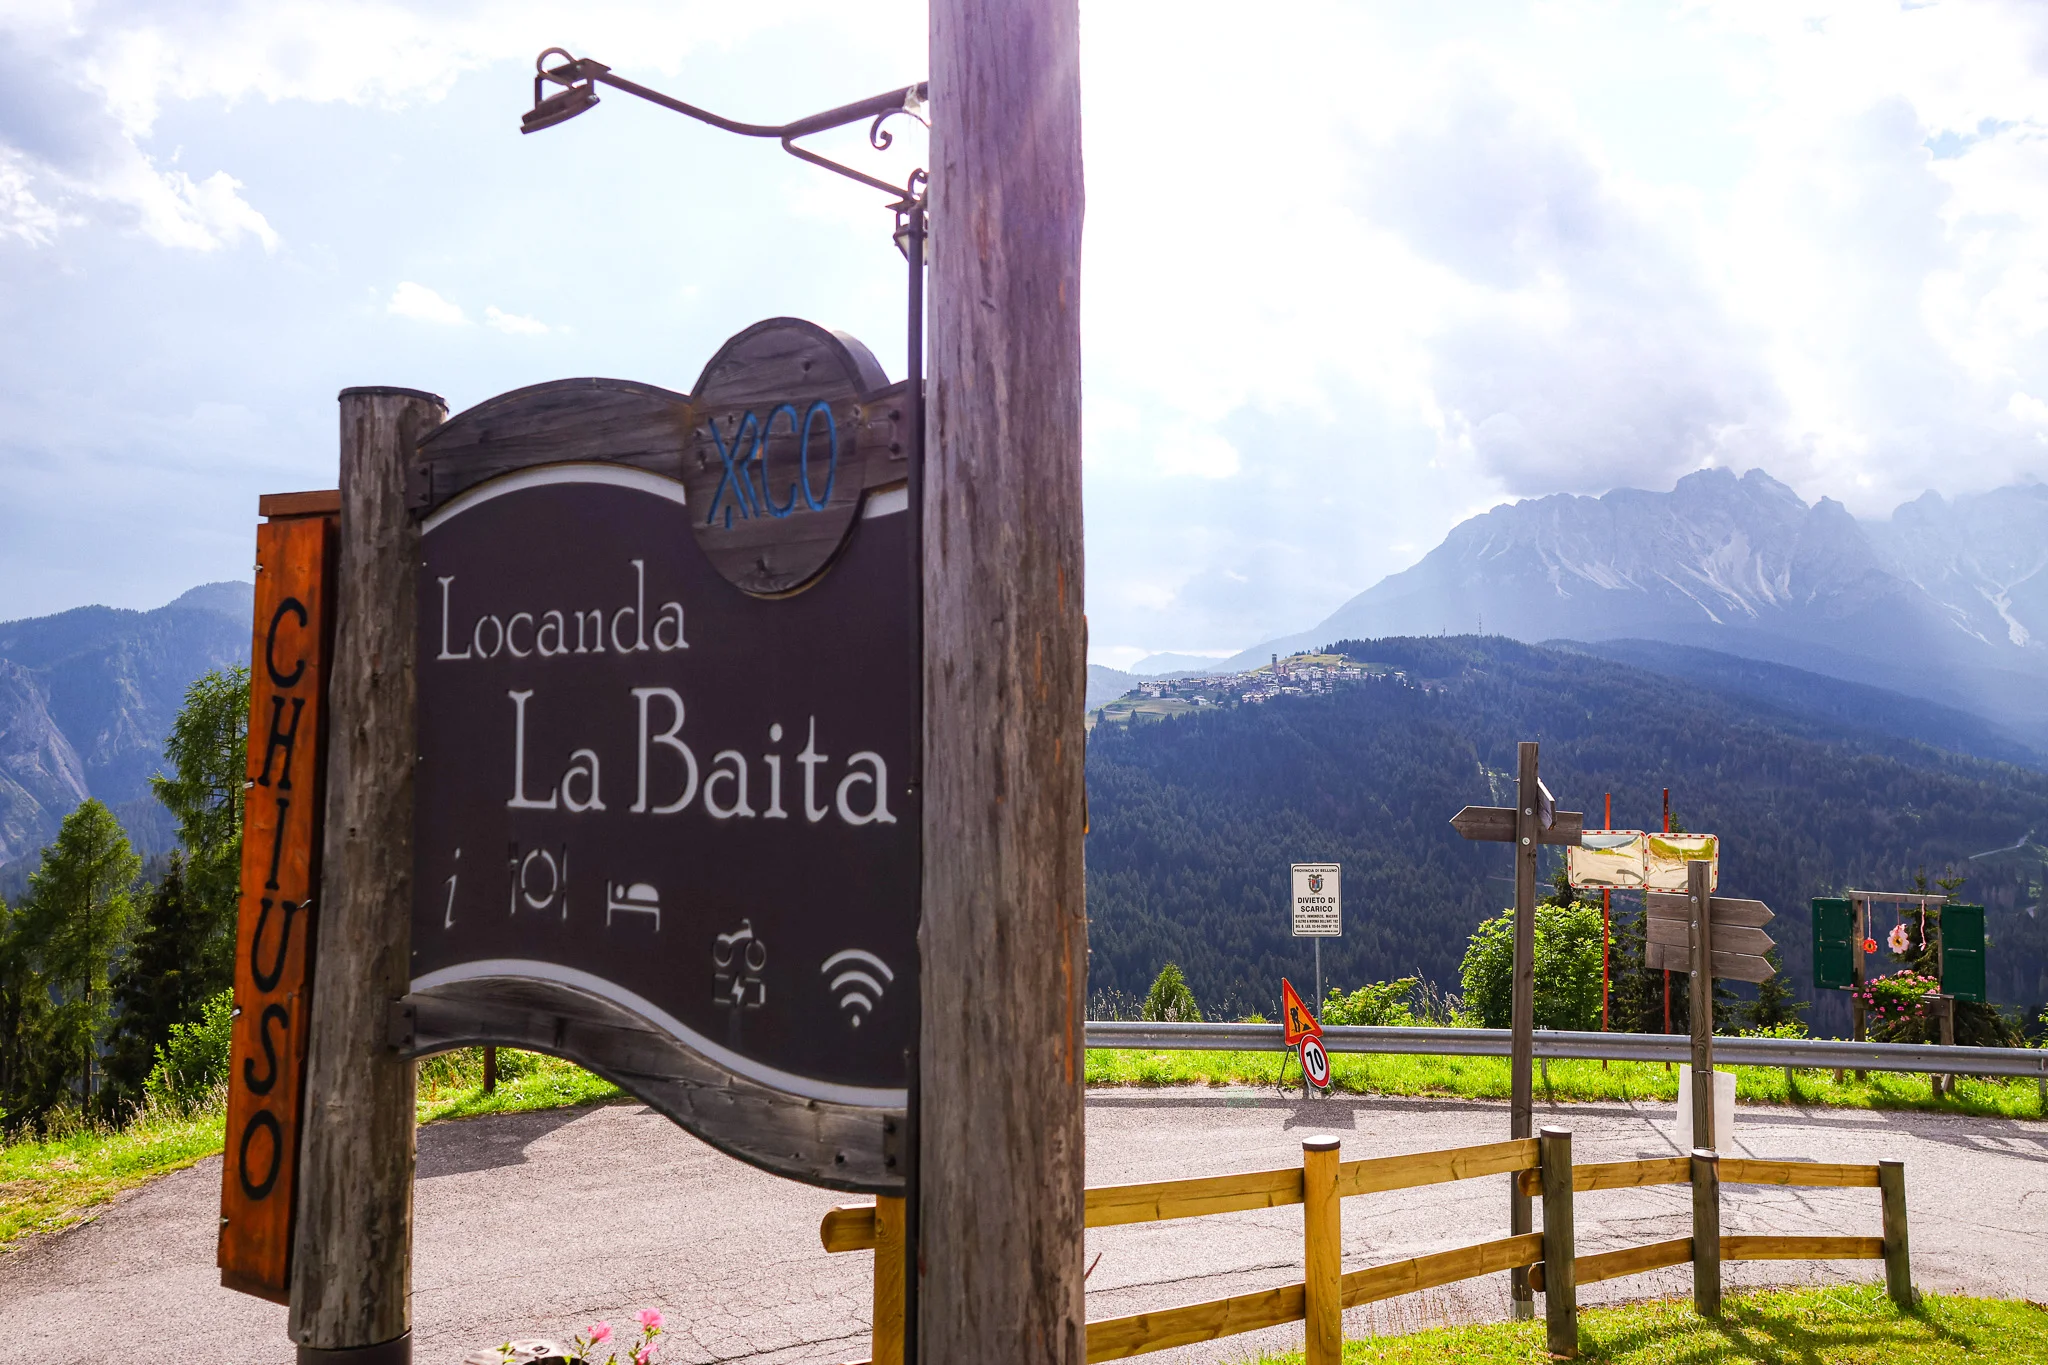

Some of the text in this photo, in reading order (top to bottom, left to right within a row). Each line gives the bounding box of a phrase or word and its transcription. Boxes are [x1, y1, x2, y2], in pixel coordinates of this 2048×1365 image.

[436, 559, 690, 661] Locanda
[507, 687, 898, 826] La Baita
[238, 597, 309, 1200] CHIUSO
[1300, 905, 1333, 913] SCARICO
[1306, 1047, 1324, 1075] 70
